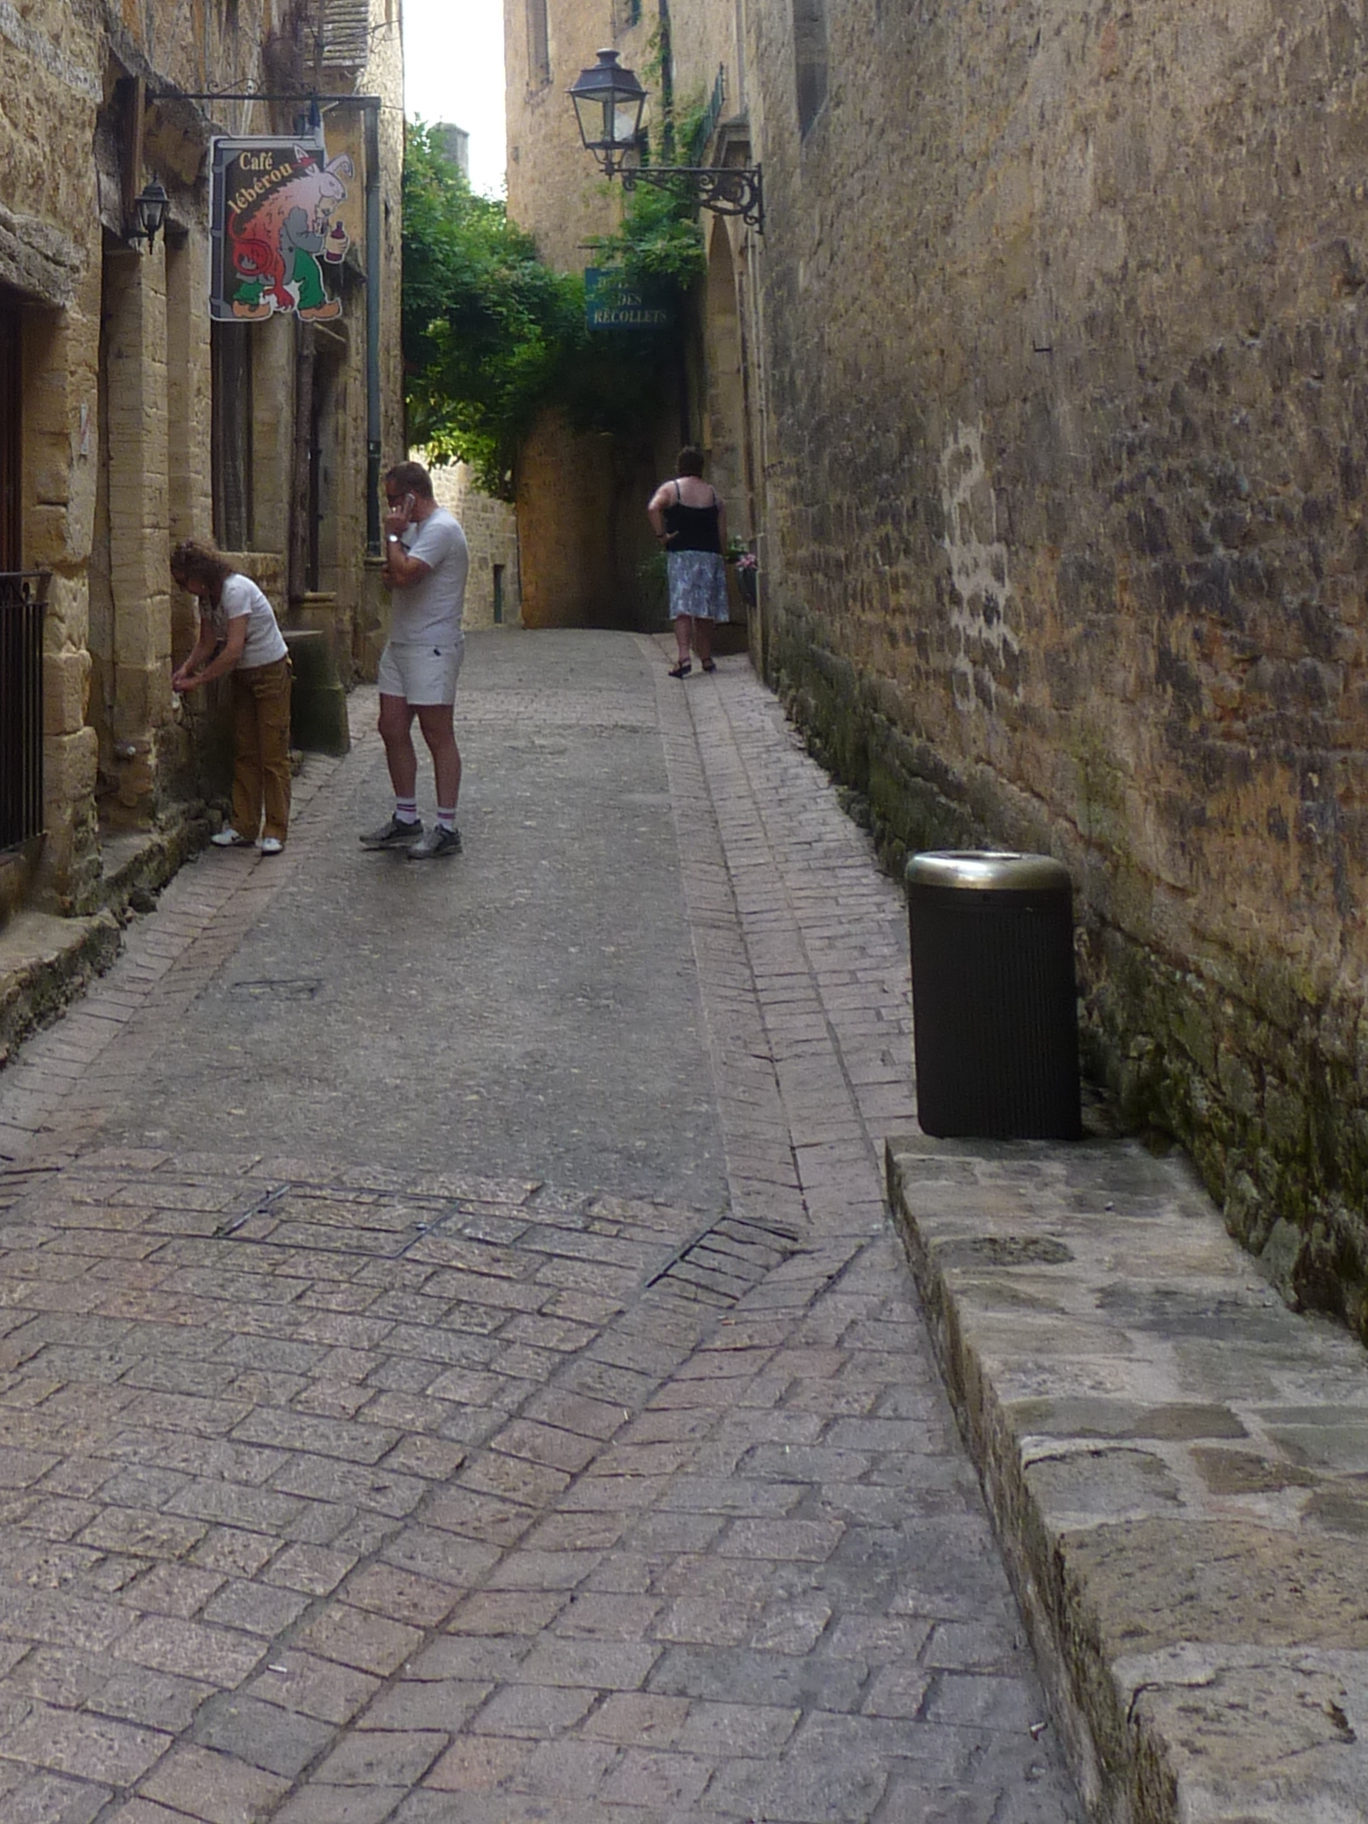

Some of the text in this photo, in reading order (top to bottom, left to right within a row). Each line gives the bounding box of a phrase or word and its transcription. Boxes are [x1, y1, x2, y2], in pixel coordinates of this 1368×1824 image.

[239, 152, 273, 171] Café
[227, 163, 293, 215] lébérou
[617, 292, 643, 306] DES
